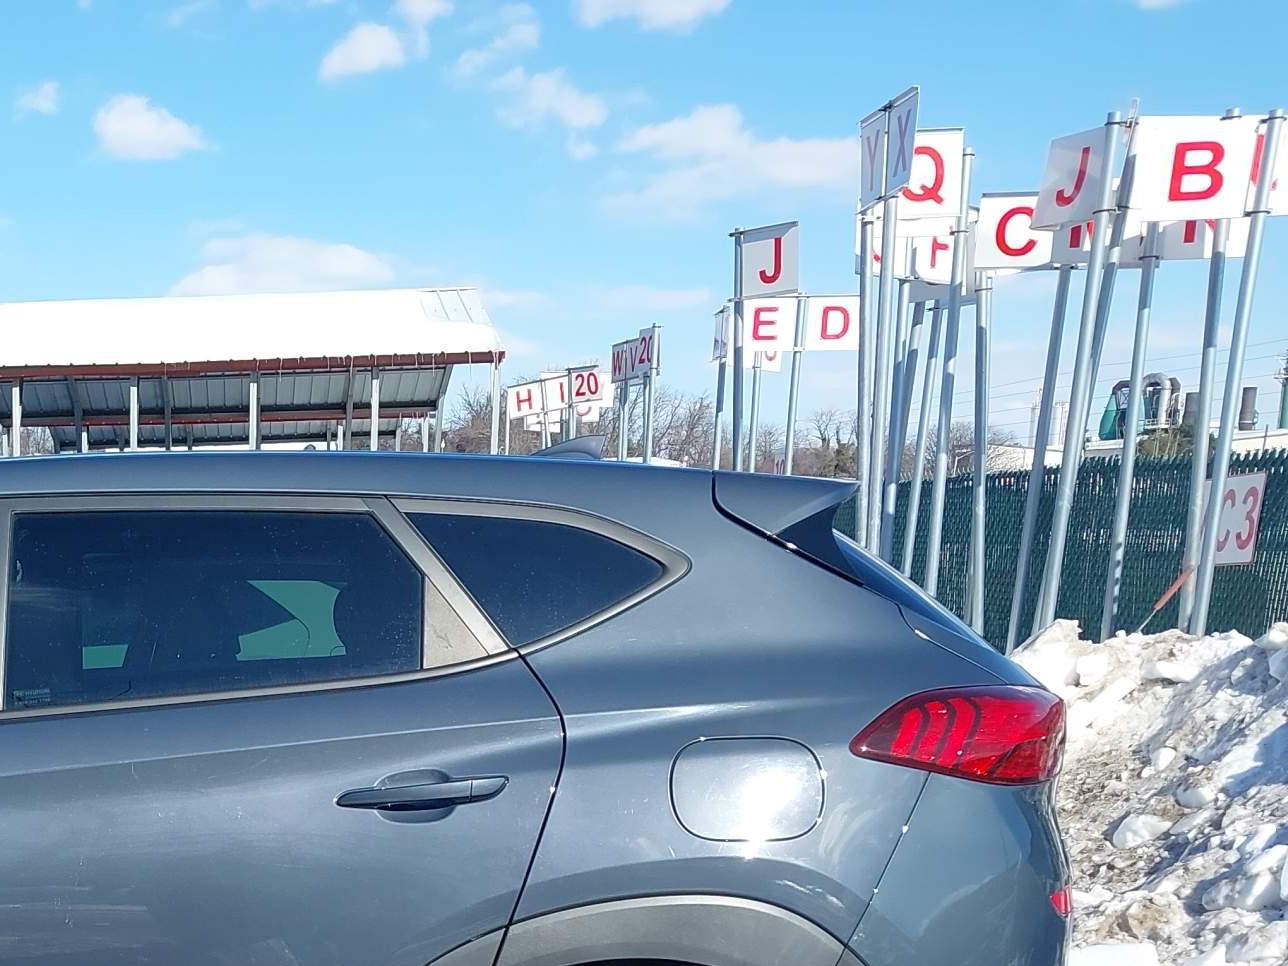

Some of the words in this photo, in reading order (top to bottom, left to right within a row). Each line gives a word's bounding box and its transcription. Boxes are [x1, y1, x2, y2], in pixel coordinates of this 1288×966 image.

[866, 128, 881, 192] Y
[892, 108, 913, 178] X
[1055, 146, 1091, 207] J
[1167, 140, 1225, 202] B
[995, 206, 1038, 256] C
[759, 236, 782, 284] J
[752, 306, 779, 340] E
[820, 306, 851, 340] D
[612, 350, 624, 377] W
[630, 345, 639, 373] V
[516, 388, 533, 413] H
[575, 371, 599, 398] 20
